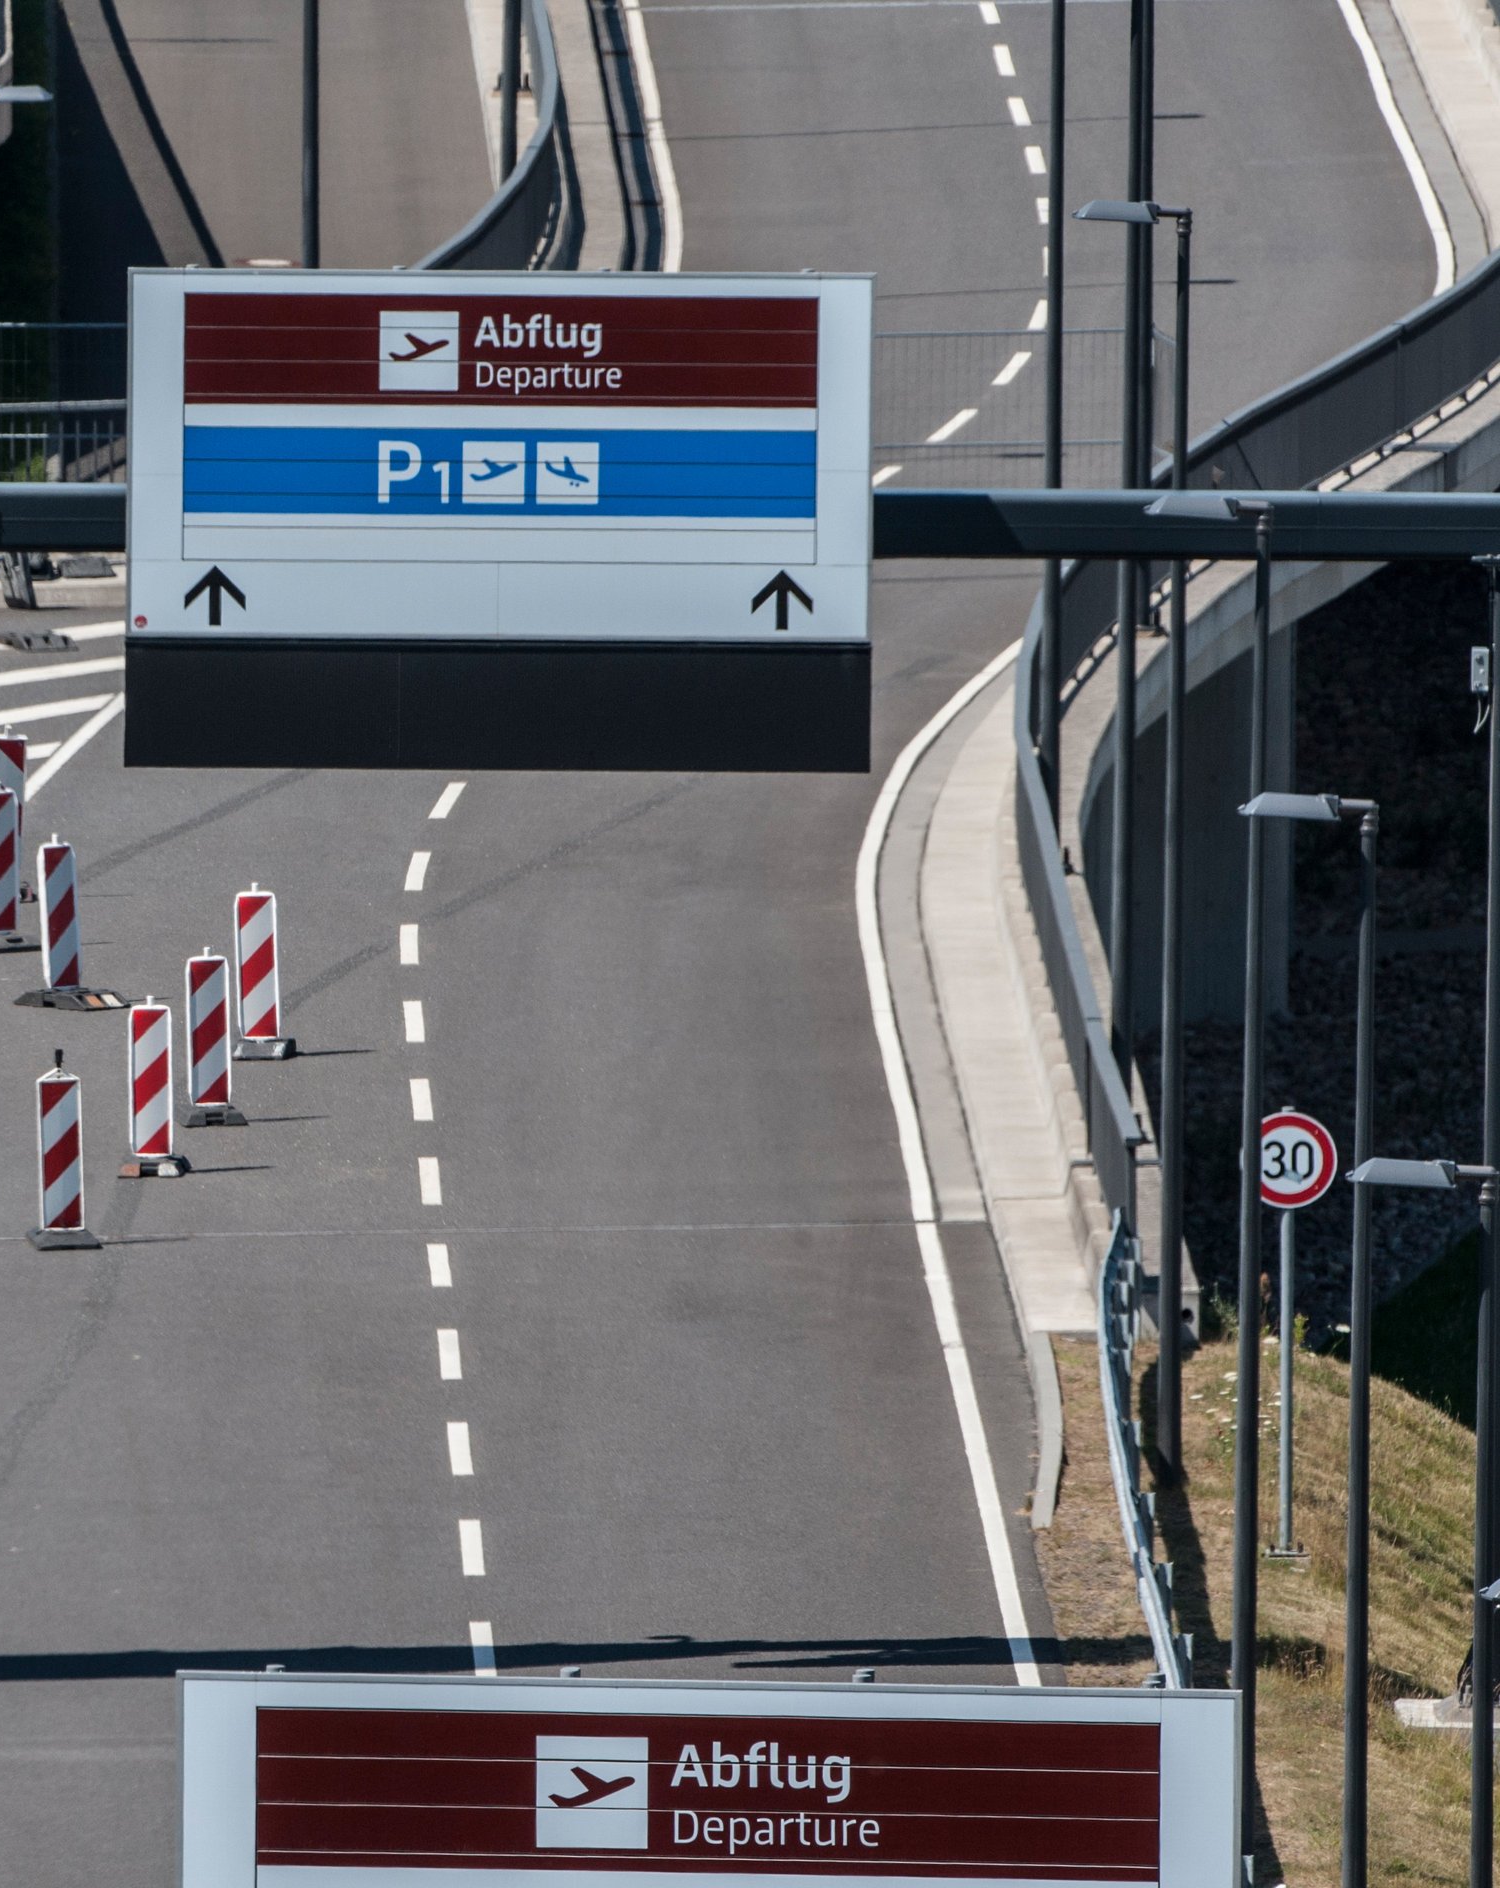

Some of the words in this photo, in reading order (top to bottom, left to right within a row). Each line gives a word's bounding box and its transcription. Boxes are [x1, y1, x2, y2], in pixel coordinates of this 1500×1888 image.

[475, 313, 602, 358] Abflug
[476, 362, 622, 395] Departure
[1263, 1140, 1314, 1181] 30
[671, 1741, 851, 1804] Abflug
[673, 1810, 880, 1855] Departure
